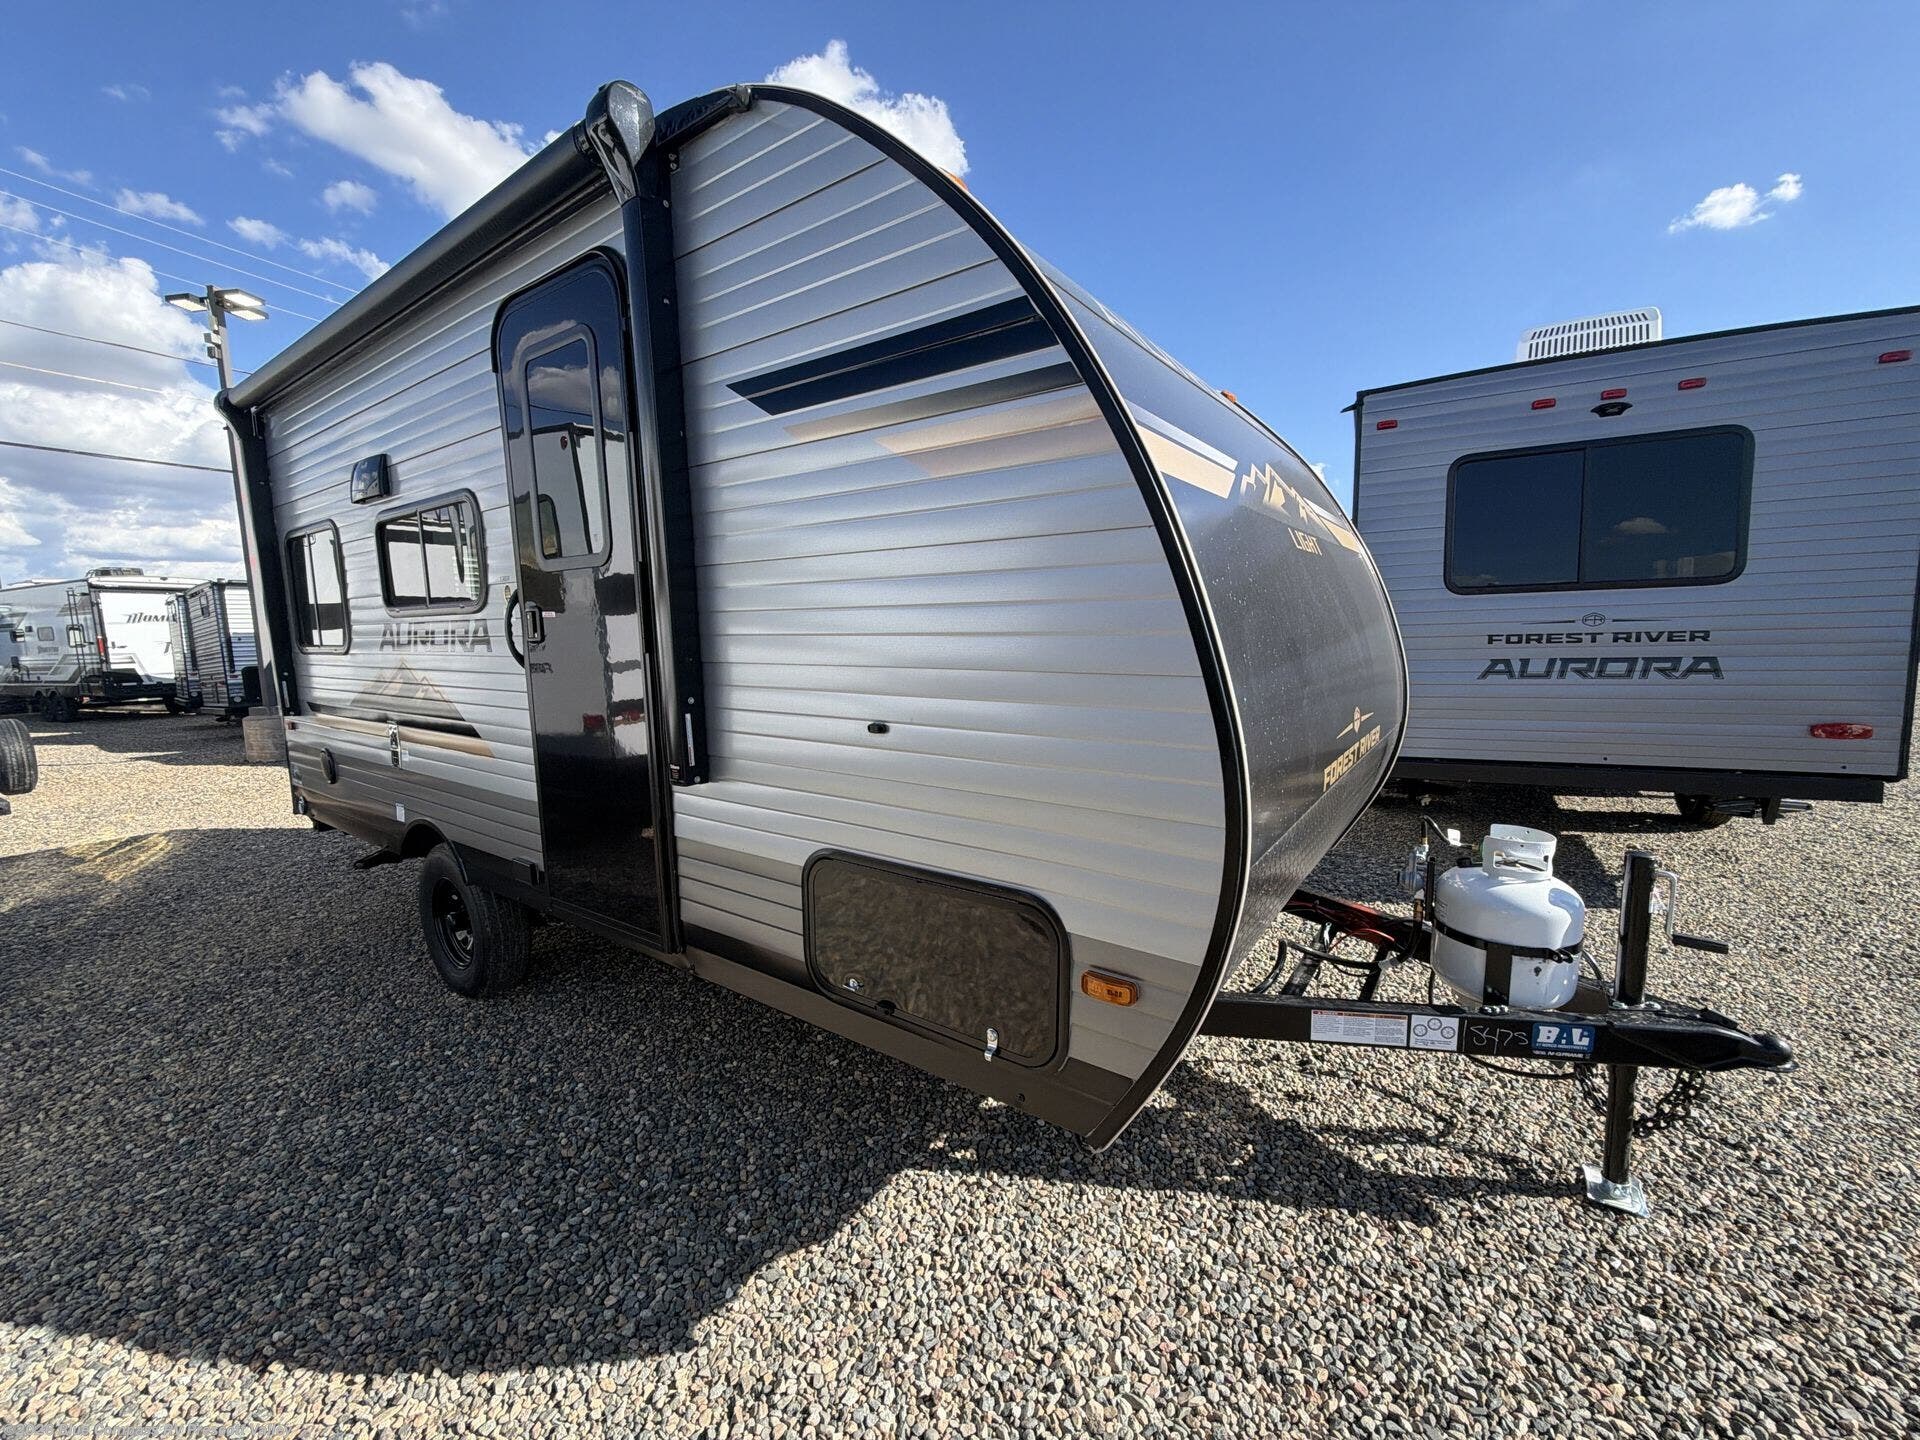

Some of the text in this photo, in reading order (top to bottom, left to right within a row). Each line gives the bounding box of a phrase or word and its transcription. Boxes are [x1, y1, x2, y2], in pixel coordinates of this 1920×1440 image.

[1288, 527, 1322, 556] LIGHT
[379, 618, 492, 653] AURORA
[1487, 630, 1711, 645] FOREST RIVER
[1476, 656, 1725, 680] AURORA
[1323, 725, 1381, 792] FOREST RIVER
